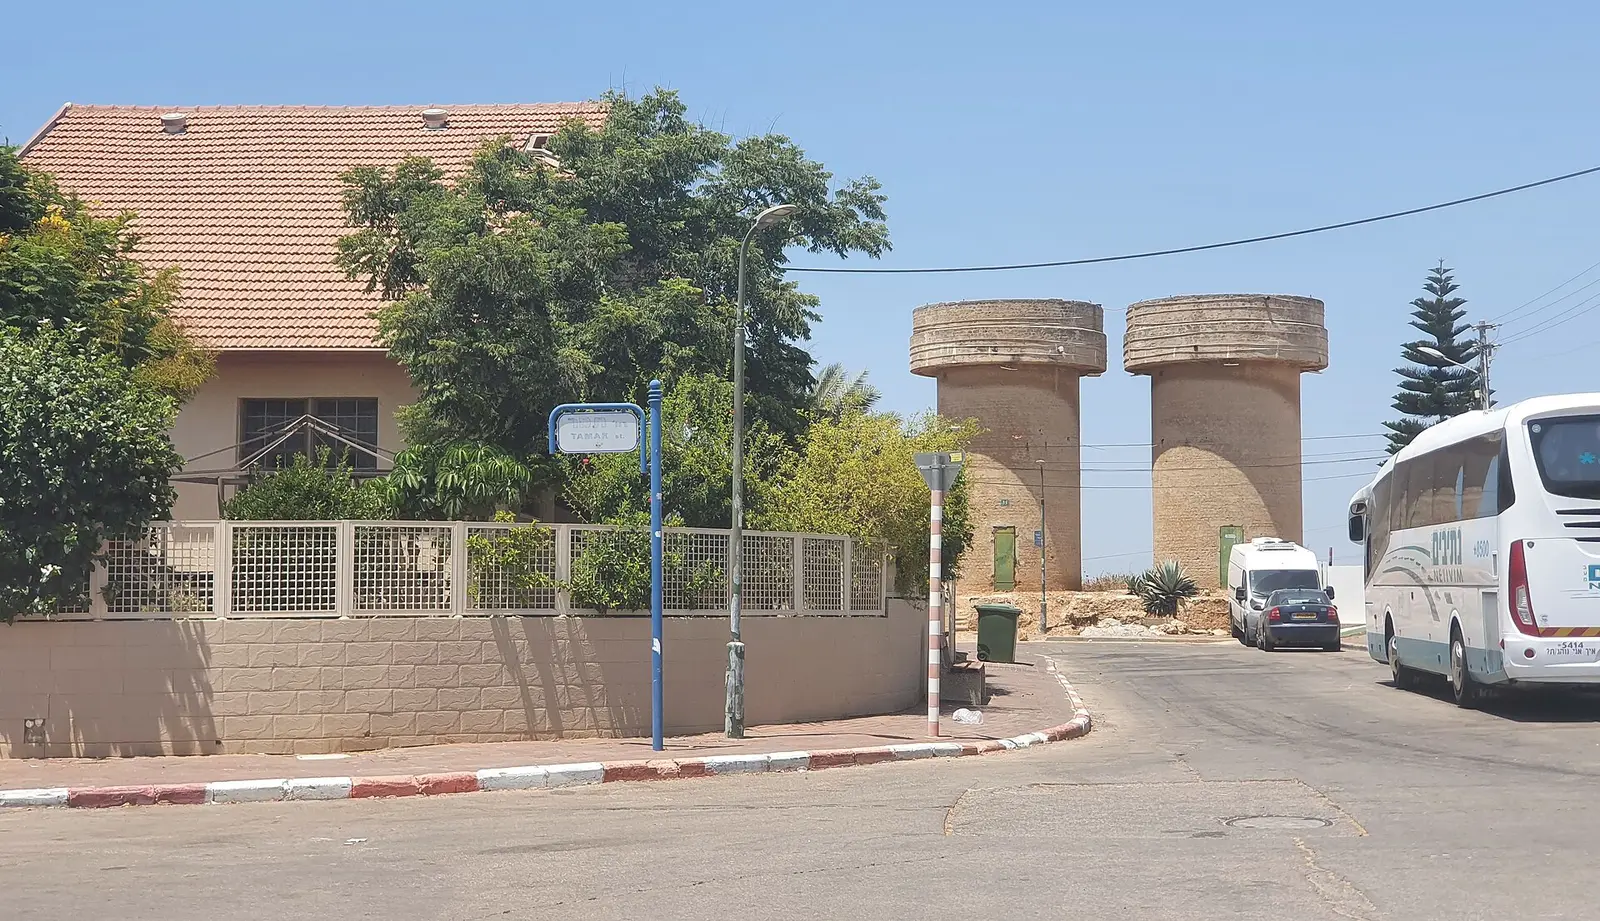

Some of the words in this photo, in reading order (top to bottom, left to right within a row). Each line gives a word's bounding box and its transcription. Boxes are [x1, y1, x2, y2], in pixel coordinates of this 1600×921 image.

[571, 432, 608, 440] TAMAR
[1433, 529, 1462, 565] נתיבים
[1433, 568, 1464, 583] NETIVIM
[1586, 648, 1596, 657] איך
